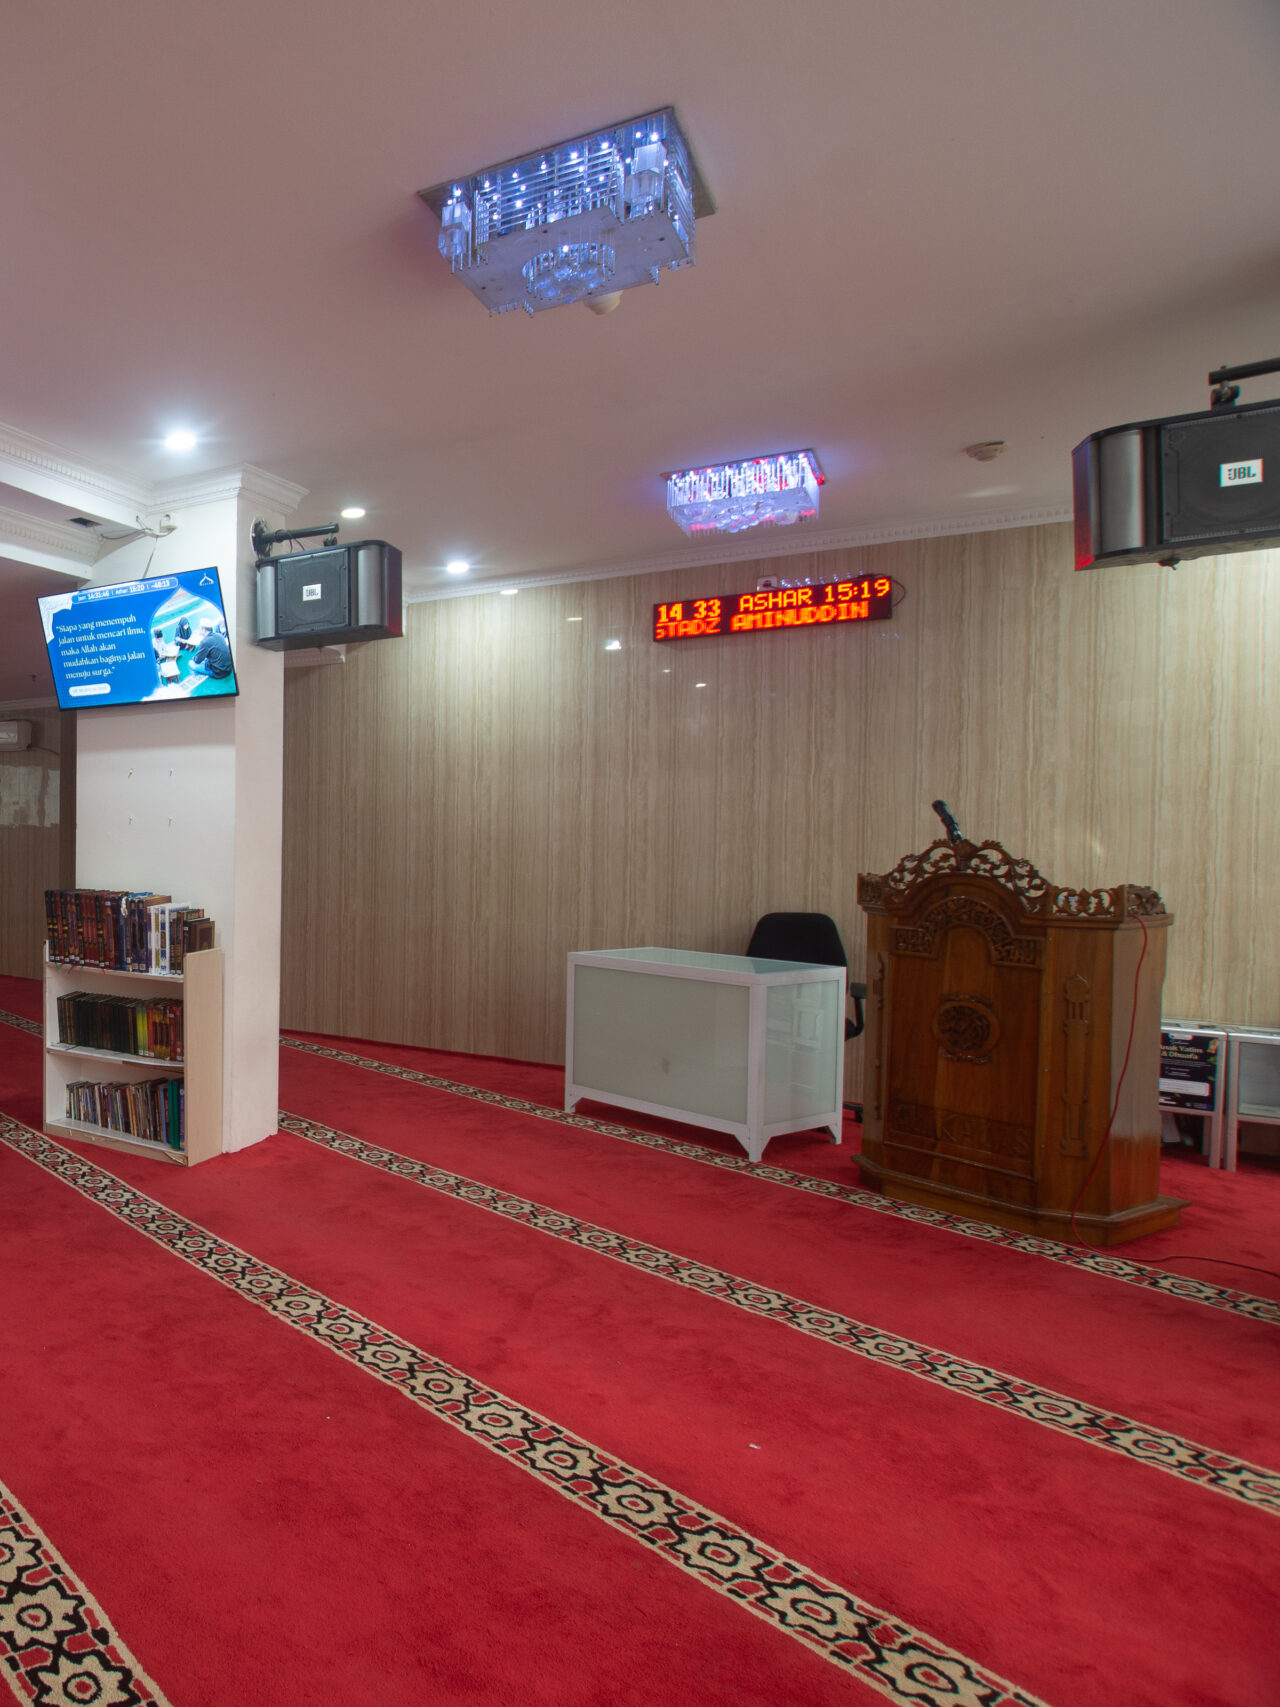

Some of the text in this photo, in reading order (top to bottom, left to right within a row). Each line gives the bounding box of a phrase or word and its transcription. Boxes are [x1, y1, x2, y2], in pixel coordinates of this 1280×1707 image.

[1227, 466, 1257, 481] JBL
[306, 588, 319, 597] JBL
[657, 578, 891, 622] 14 33 ASHAR 15:19
[78, 621, 95, 631] yang
[95, 613, 136, 628] menempuh
[730, 600, 869, 632] AMINUDDIN
[76, 632, 96, 643] untuk
[96, 627, 127, 640] mencari
[61, 642, 117, 656] maka Allah akan
[63, 650, 146, 668] mudahkan baginya jalan
[66, 668, 91, 680] menuju
[1168, 1051, 1198, 1059] Dhuafa
[1179, 1045, 1203, 1053] Yatim
